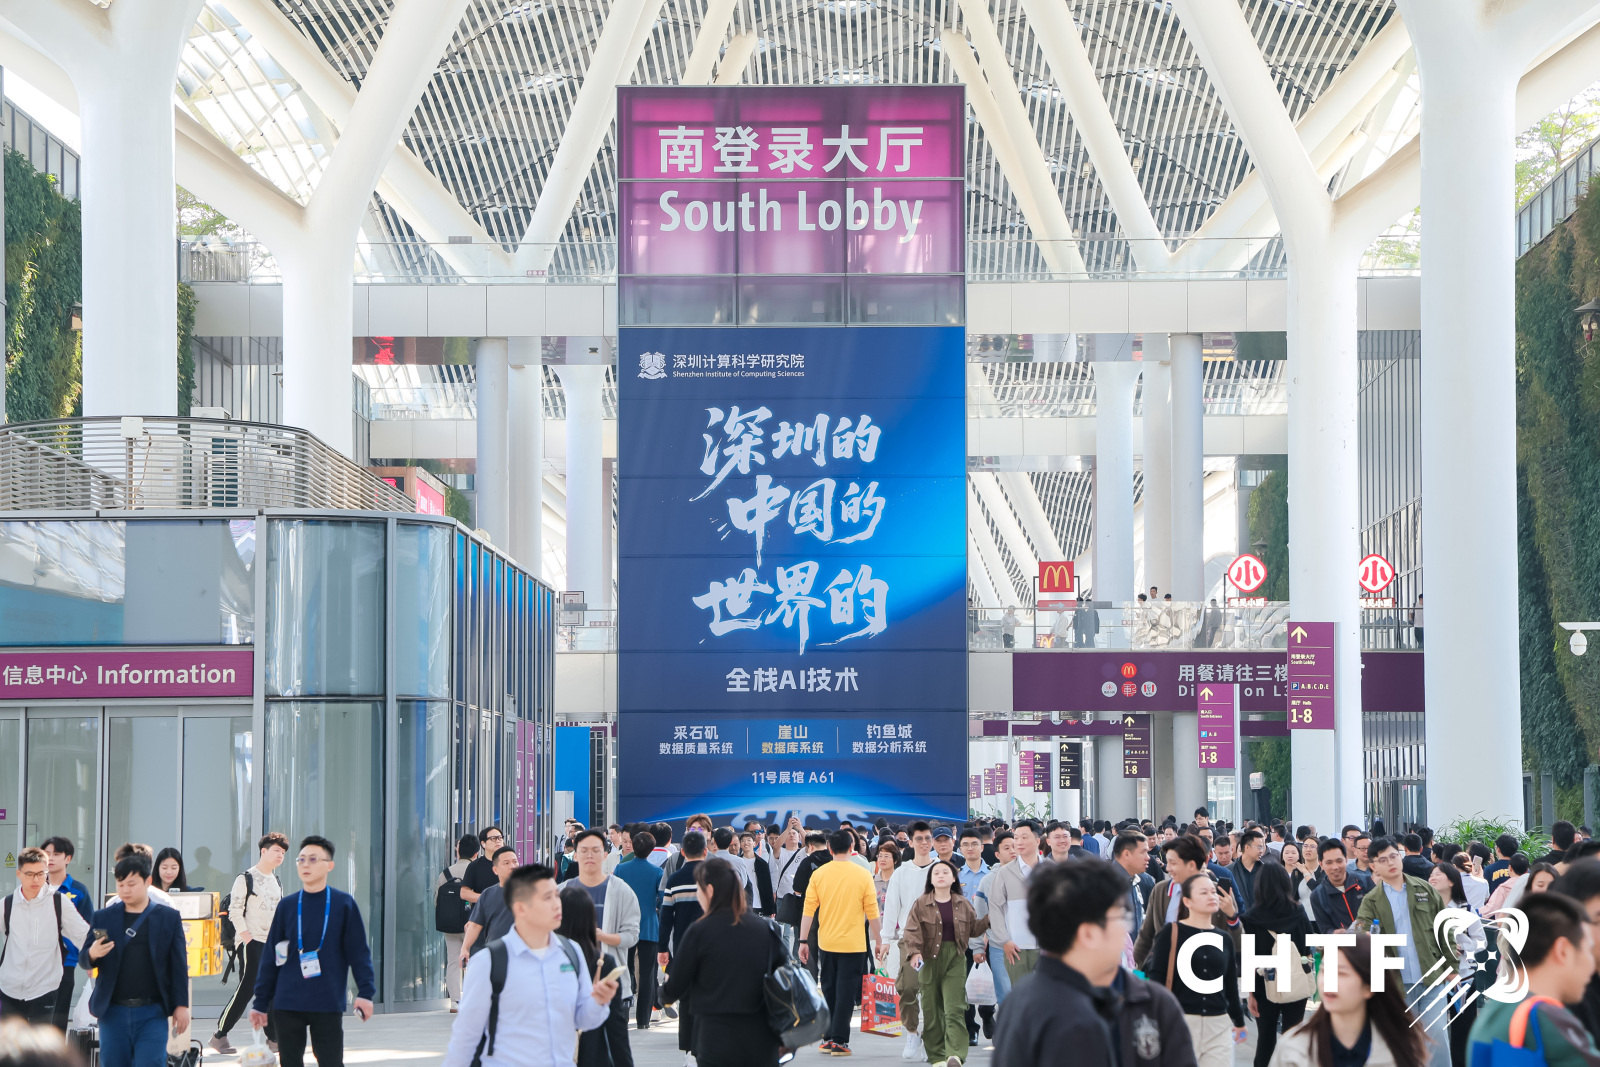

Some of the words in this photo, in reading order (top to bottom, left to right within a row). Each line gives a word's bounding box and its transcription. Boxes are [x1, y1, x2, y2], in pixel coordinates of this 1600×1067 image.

[658, 124, 924, 174] 南登录大厅
[659, 188, 782, 232] South
[798, 187, 923, 244] Lobby
[672, 353, 805, 369] 深圳计算科学研究院
[672, 370, 704, 378] Shenzhen
[705, 370, 732, 378] Institute
[733, 370, 741, 378] of
[741, 370, 776, 379] Computing
[777, 370, 805, 378] Sciences
[689, 405, 881, 502] 深圳的
[718, 474, 886, 570] 中国的
[692, 561, 889, 656] 世界的
[3, 664, 88, 686] 信息中心
[97, 663, 236, 685] Information
[726, 666, 859, 693] 全栈AI技术
[1178, 663, 1288, 682] 用餐请往三楼
[1290, 708, 1313, 723] 1-8
[673, 725, 719, 740] 采石矶
[778, 724, 808, 740] 崖山
[866, 724, 913, 740] 钓鱼城
[659, 742, 734, 755] 数据质量系统
[761, 741, 824, 755] 数据库系统
[852, 740, 928, 754] 数据分析系统
[1200, 751, 1218, 764] 1-8
[751, 770, 805, 784] 11号展馆
[808, 770, 834, 784] A61
[1124, 765, 1138, 775] 1-8
